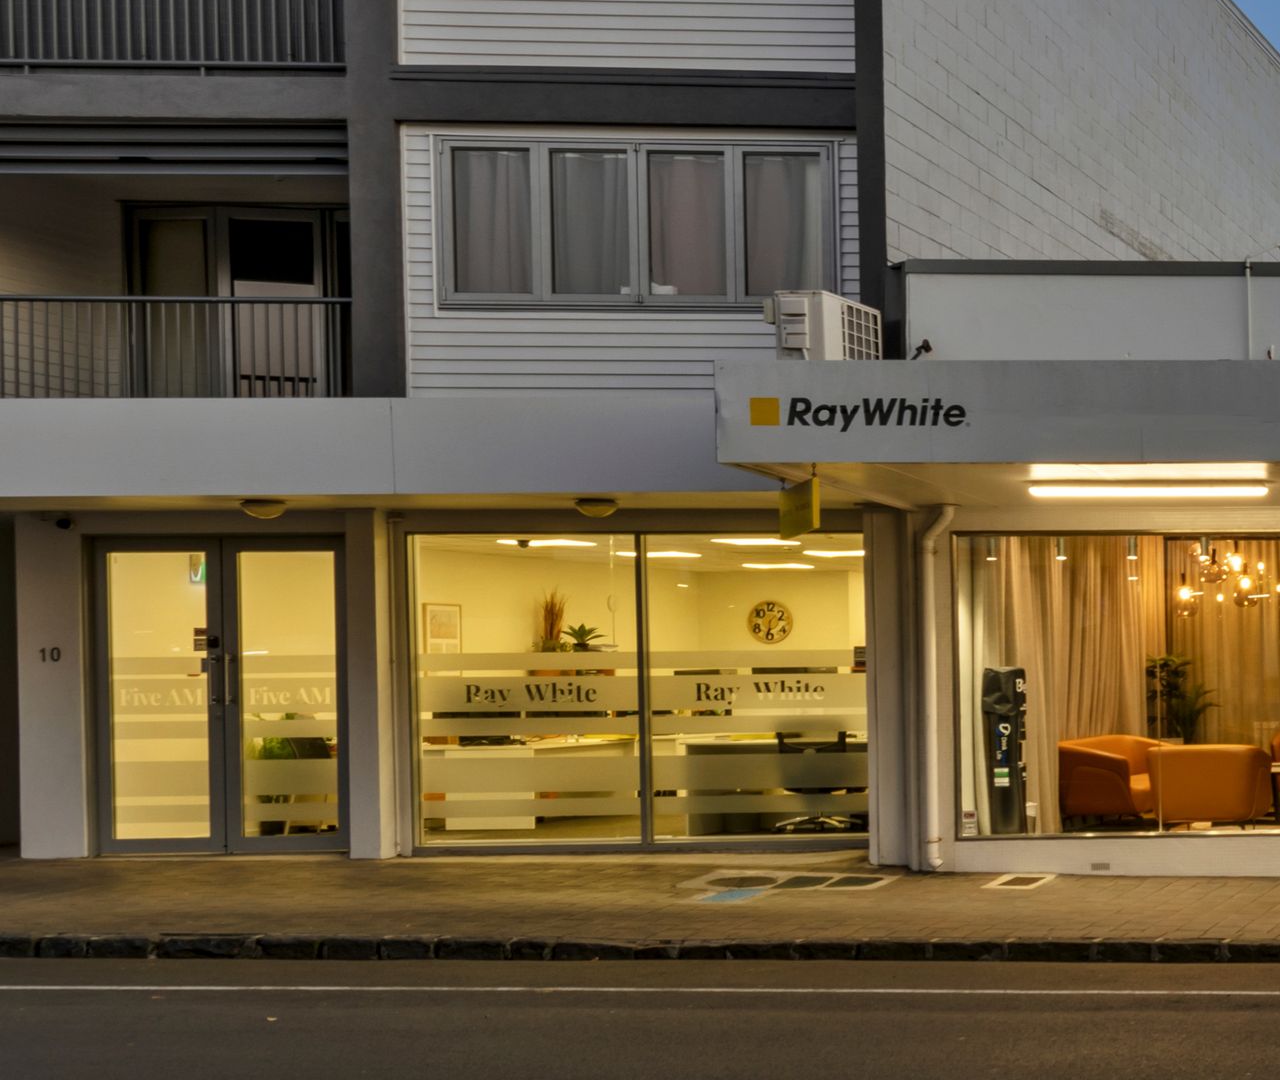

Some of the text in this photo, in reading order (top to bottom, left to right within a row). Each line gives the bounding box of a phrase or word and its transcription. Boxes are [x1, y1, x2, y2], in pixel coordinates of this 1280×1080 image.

[38, 647, 61, 662] 10
[119, 687, 202, 707] Five AM
[249, 686, 331, 705] Five AM
[465, 682, 597, 708] Ray White
[695, 680, 825, 706] Ray White
